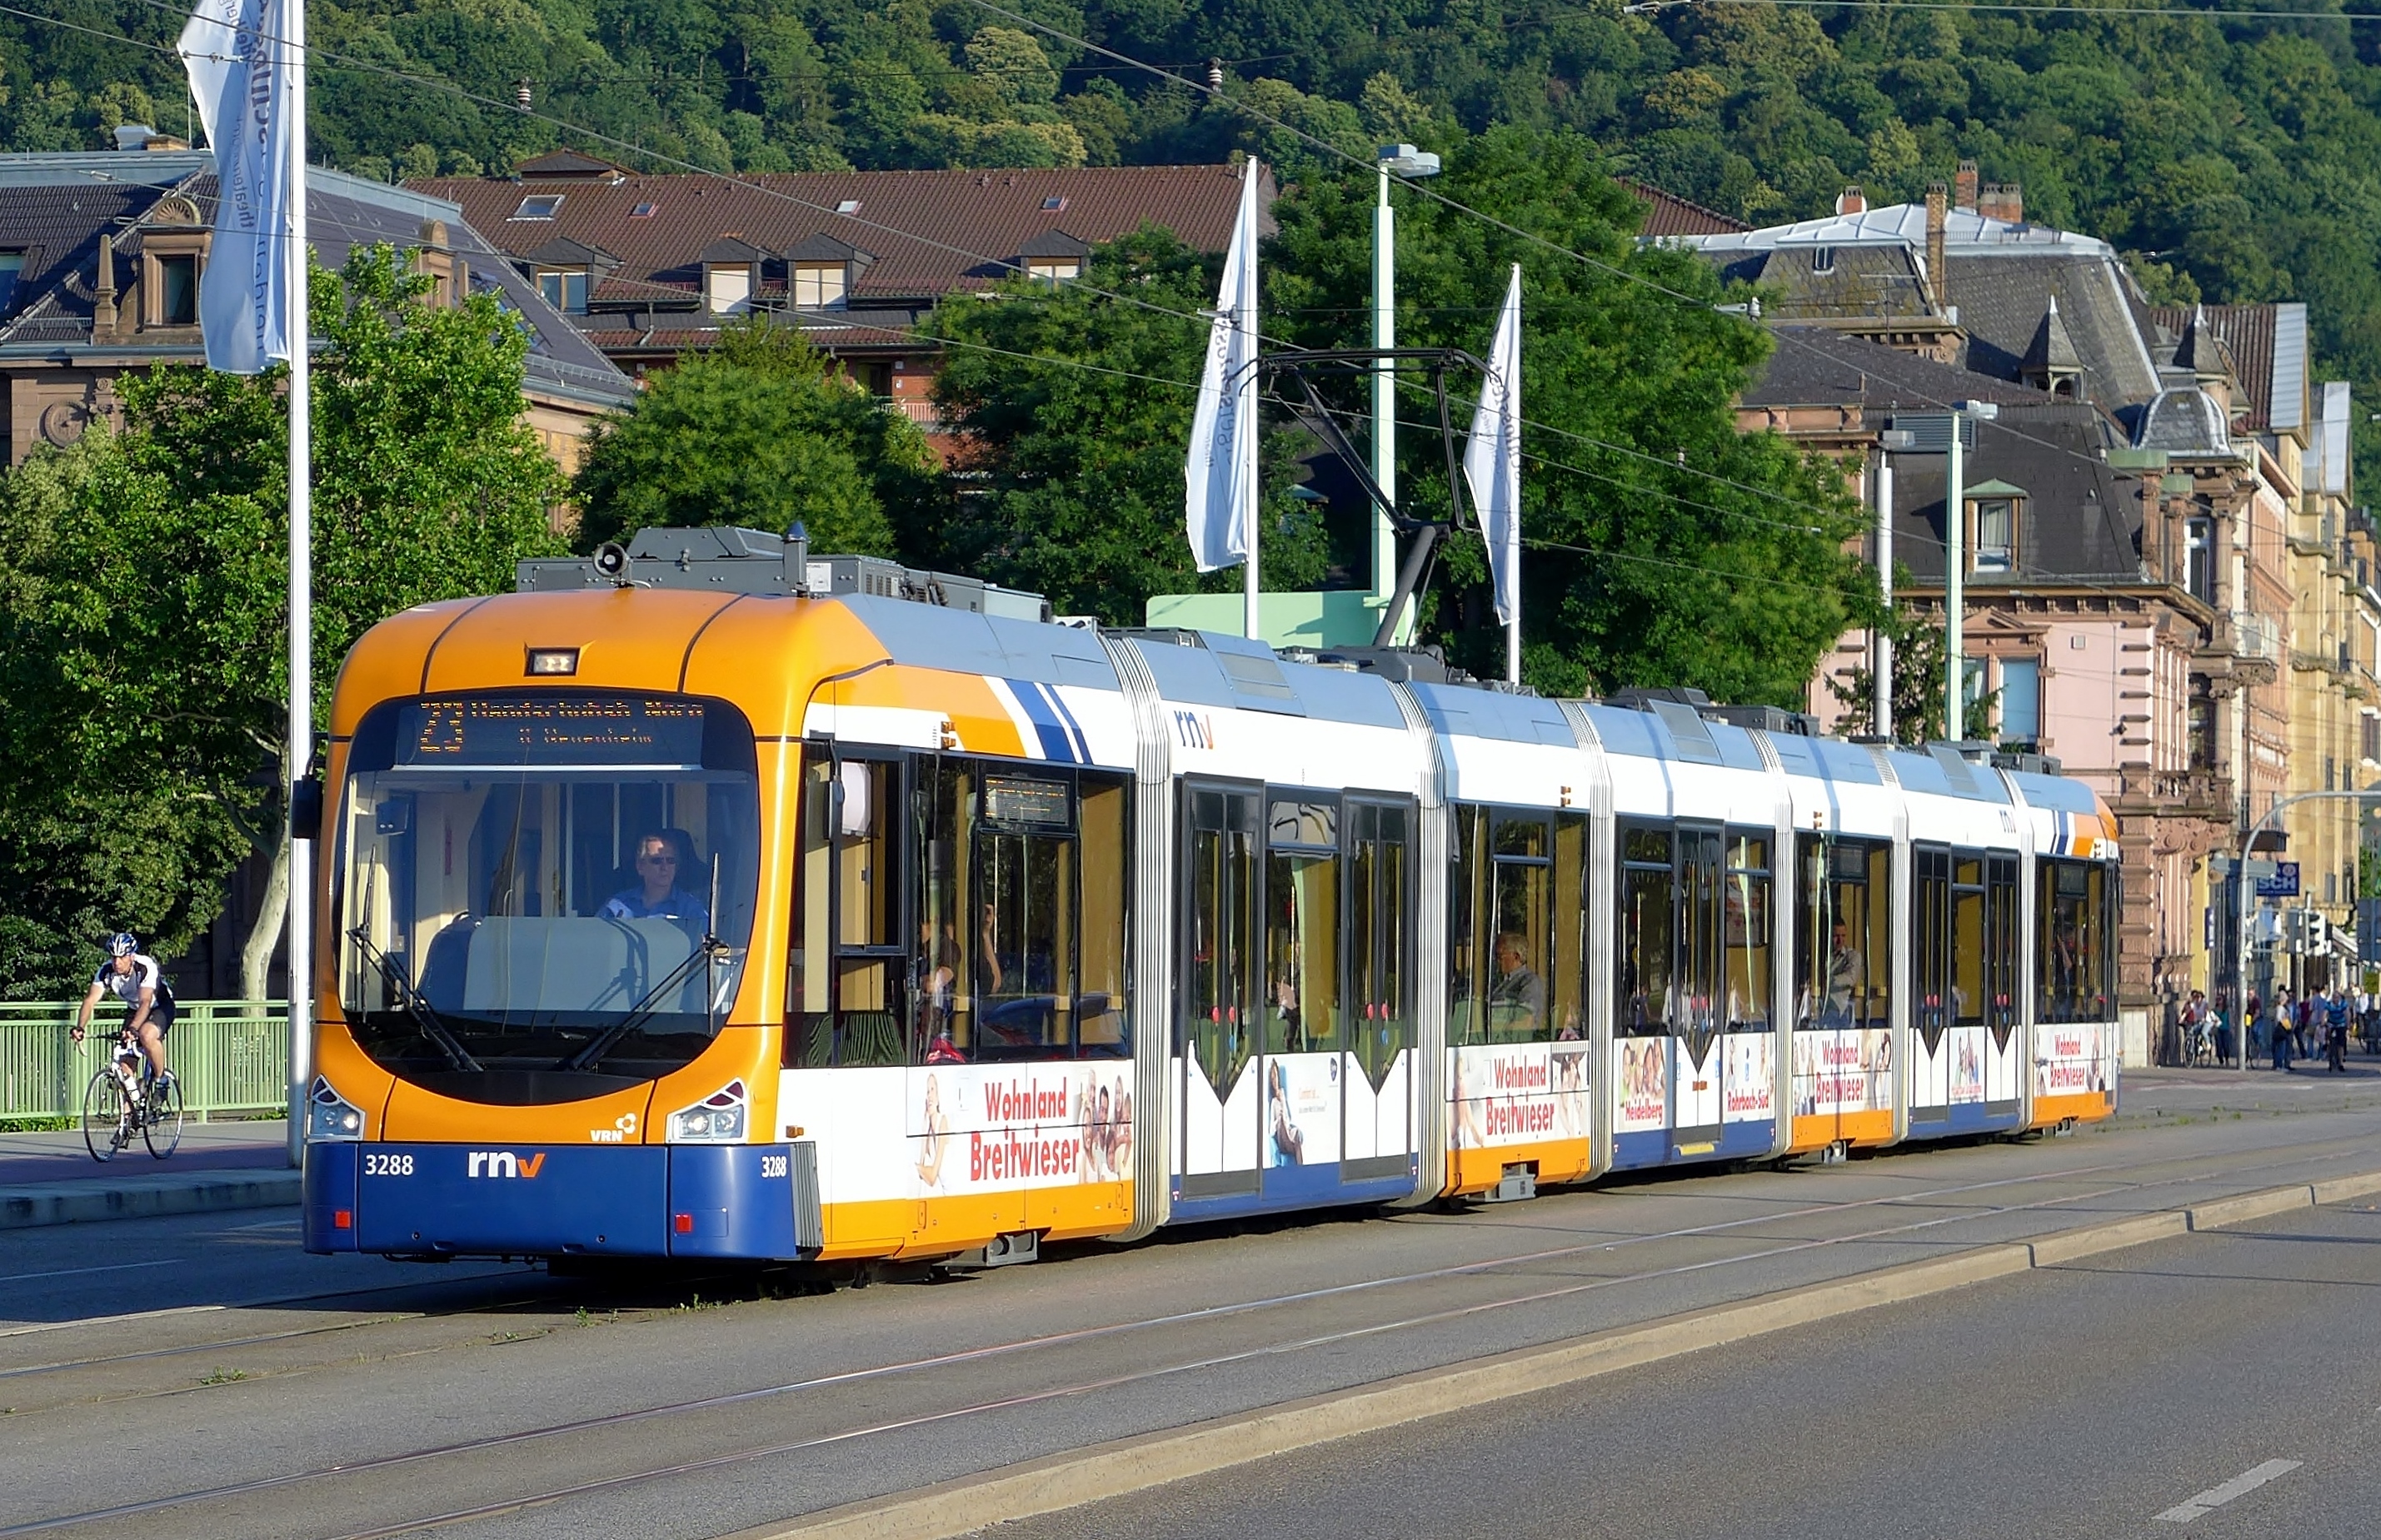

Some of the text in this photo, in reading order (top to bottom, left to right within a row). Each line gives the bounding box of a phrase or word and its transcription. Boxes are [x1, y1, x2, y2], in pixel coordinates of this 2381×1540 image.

[1174, 710, 1214, 750] rnv
[1822, 1036, 1859, 1066] Wohnland
[1494, 1053, 1547, 1090] Wohnland
[1815, 1068, 1864, 1104] Breitwieser
[984, 1076, 1067, 1122] Wohnland
[1485, 1092, 1555, 1136] Breitwieser
[1625, 1097, 1664, 1125] Heidelberg
[590, 1129, 623, 1143] VRN
[970, 1123, 1080, 1182] Breitwieser
[364, 1154, 414, 1177] 3288
[467, 1151, 546, 1179] rnv
[761, 1155, 787, 1179] 3288
